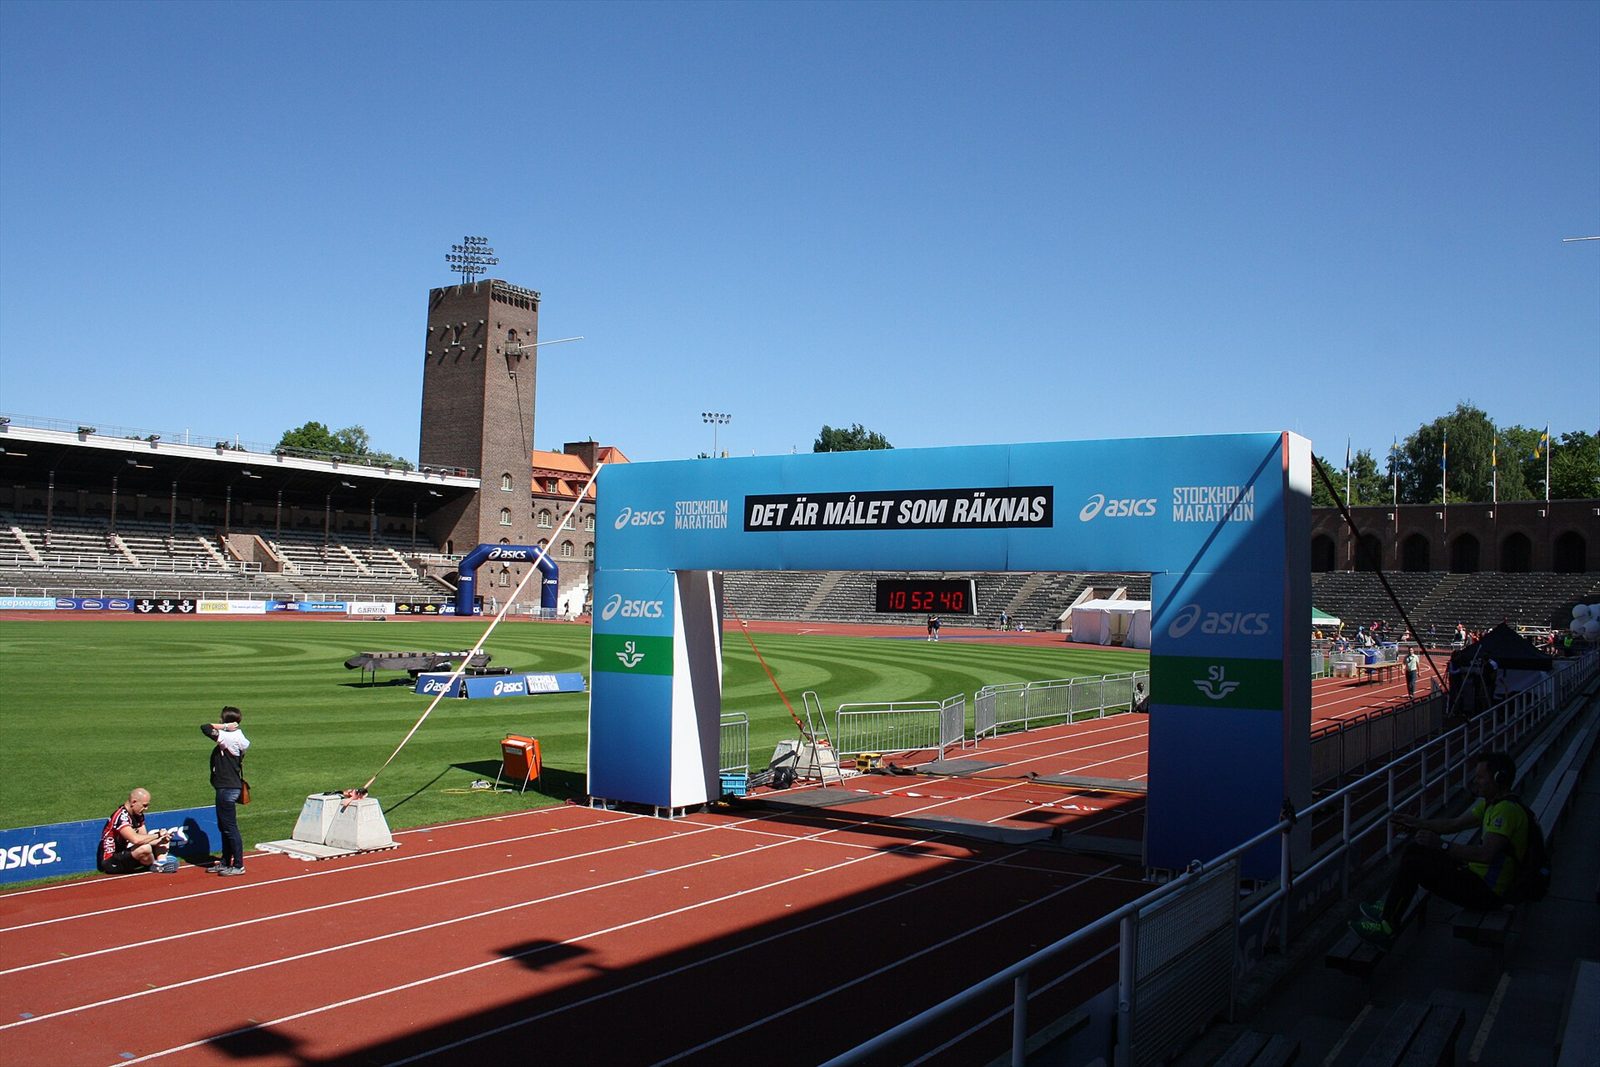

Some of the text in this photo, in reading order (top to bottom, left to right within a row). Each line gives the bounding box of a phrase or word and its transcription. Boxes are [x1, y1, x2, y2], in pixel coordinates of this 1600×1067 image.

[1173, 486, 1254, 505] STOCKHOLM
[675, 500, 728, 515] STOCKHOLM
[750, 492, 1047, 527] DET ÄR MÅLET SOM RÄKNAS
[1173, 504, 1254, 522] MARATHON
[675, 514, 728, 529] MARATHON
[889, 591, 964, 611] 10 52 40
[625, 641, 636, 654] SJ
[1208, 665, 1225, 681] SJ
